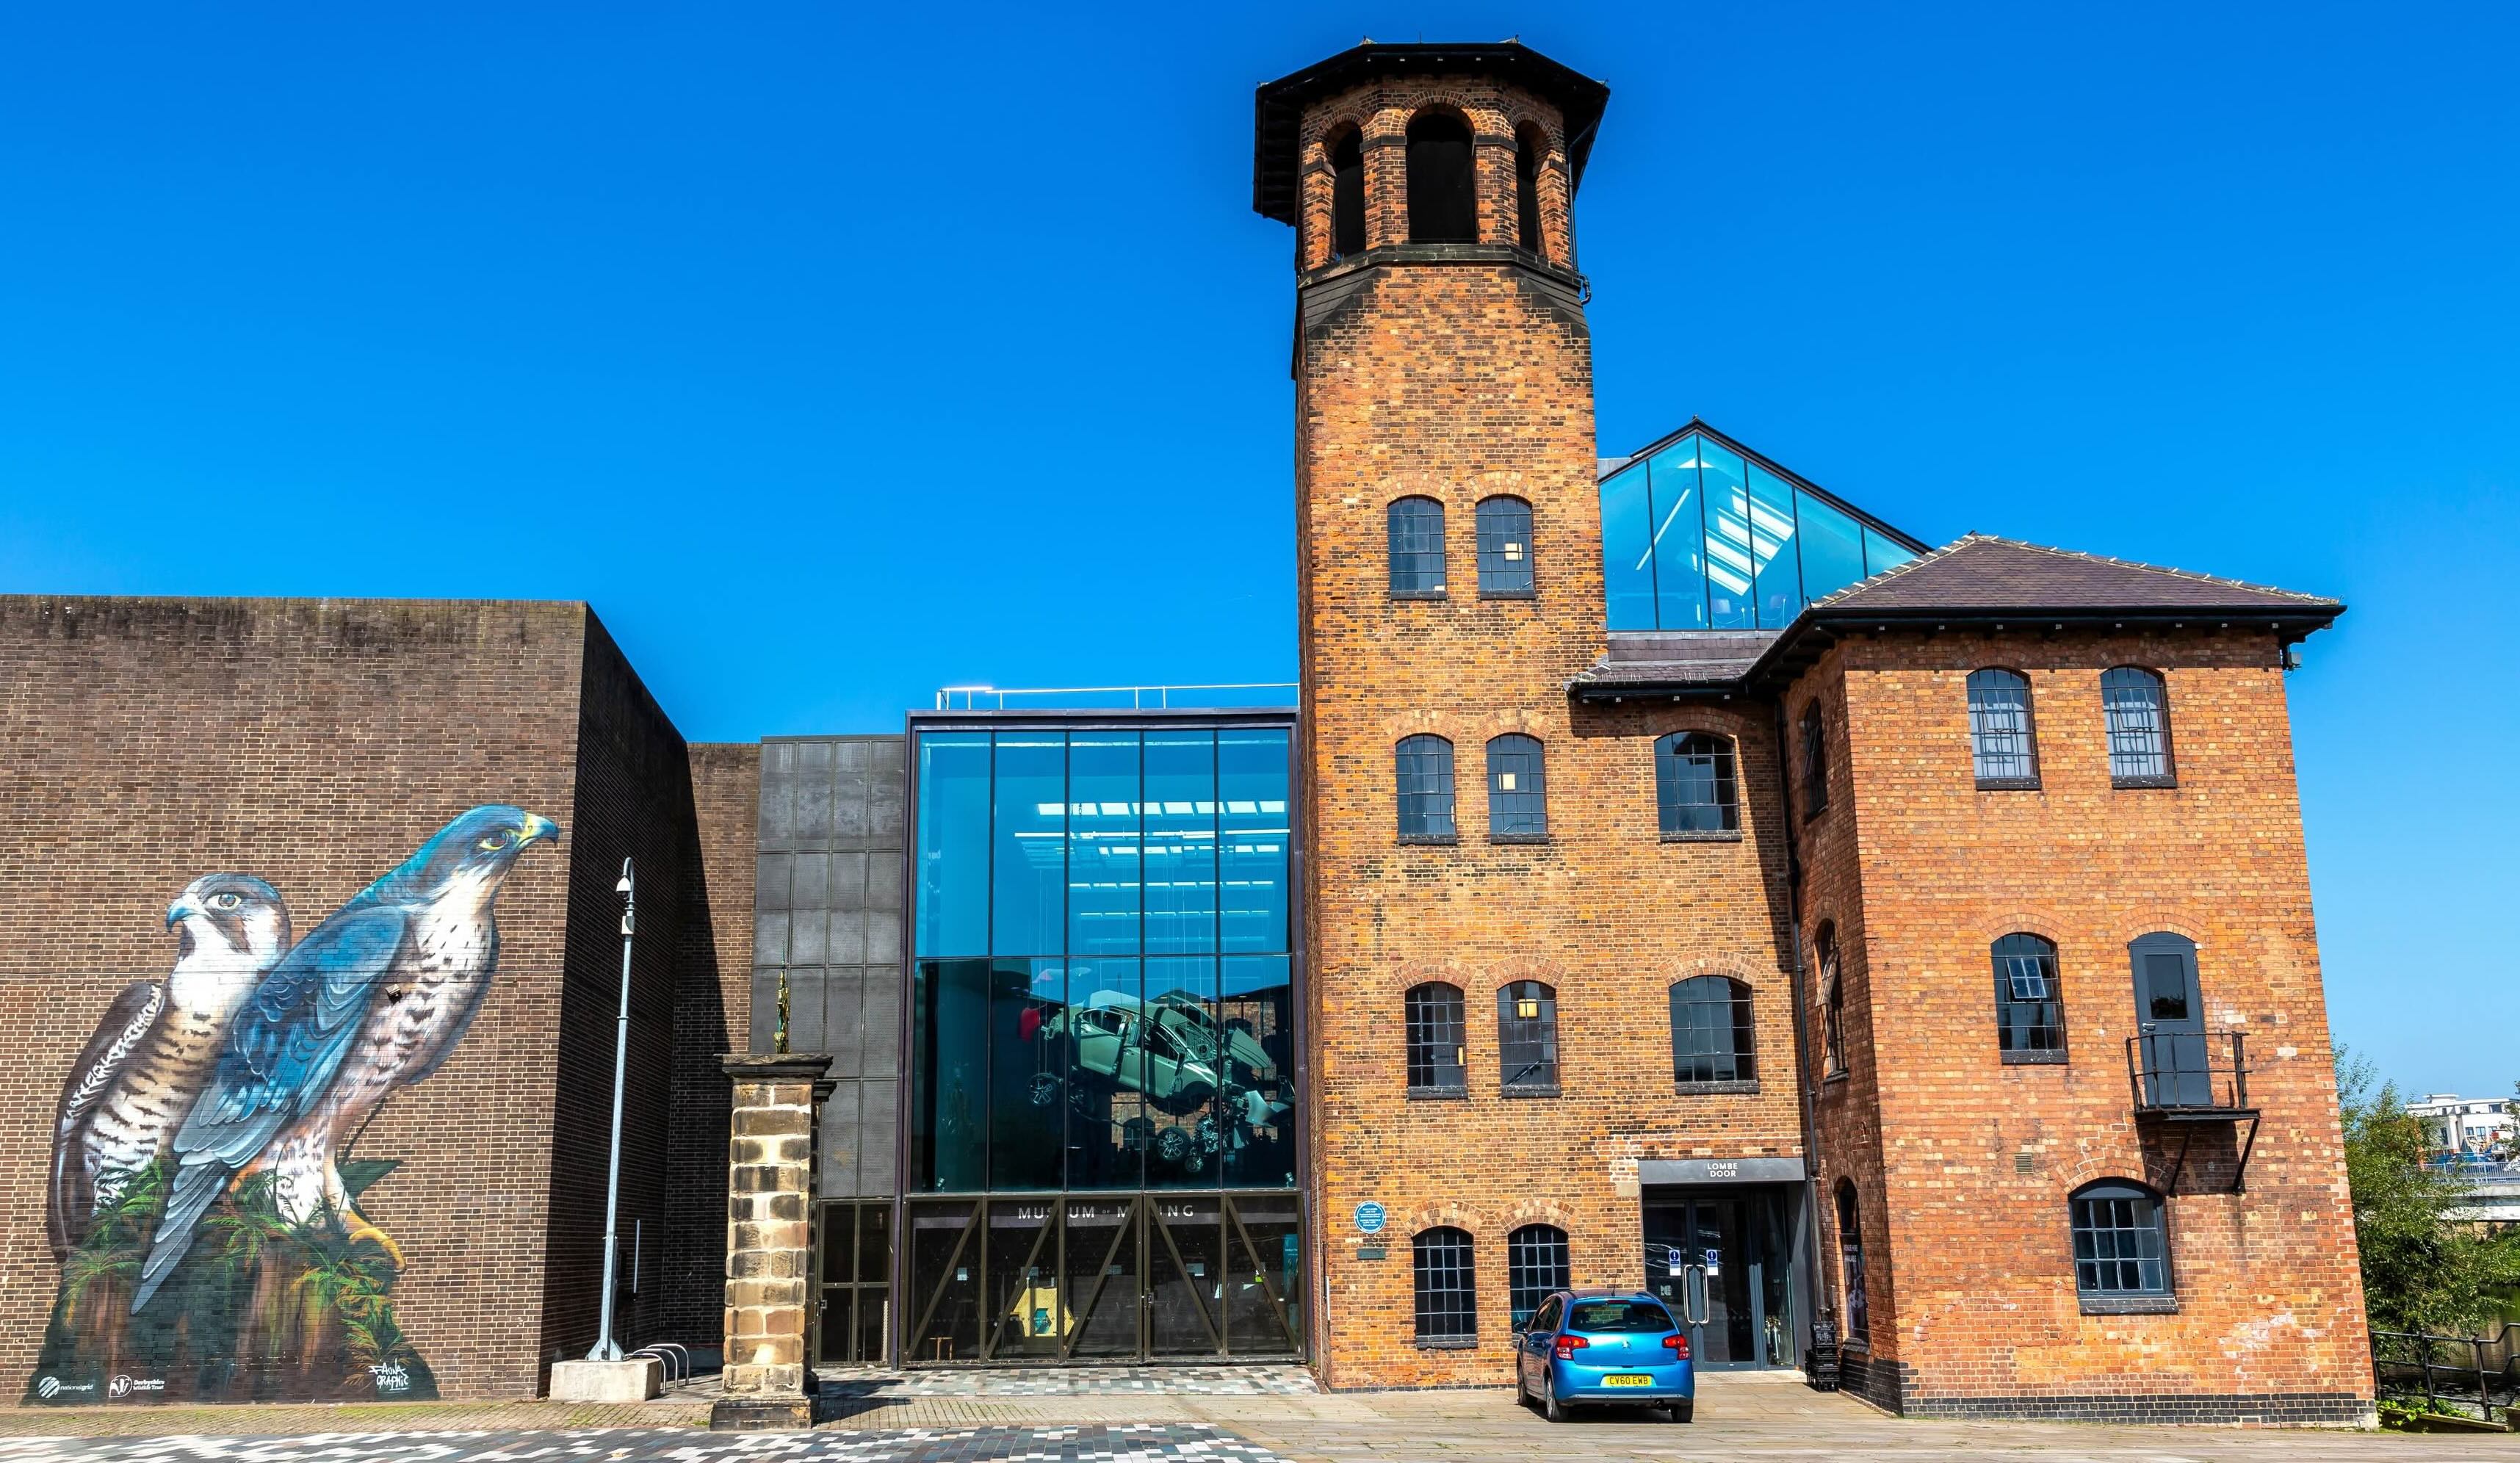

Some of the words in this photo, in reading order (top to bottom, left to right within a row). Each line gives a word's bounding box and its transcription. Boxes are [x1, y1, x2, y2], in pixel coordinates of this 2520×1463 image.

[1018, 1206, 1094, 1219] MUSUM
[1117, 1204, 1194, 1218] MING
[1609, 1376, 1631, 1384] CV60
[1632, 1376, 1648, 1384] EWB
